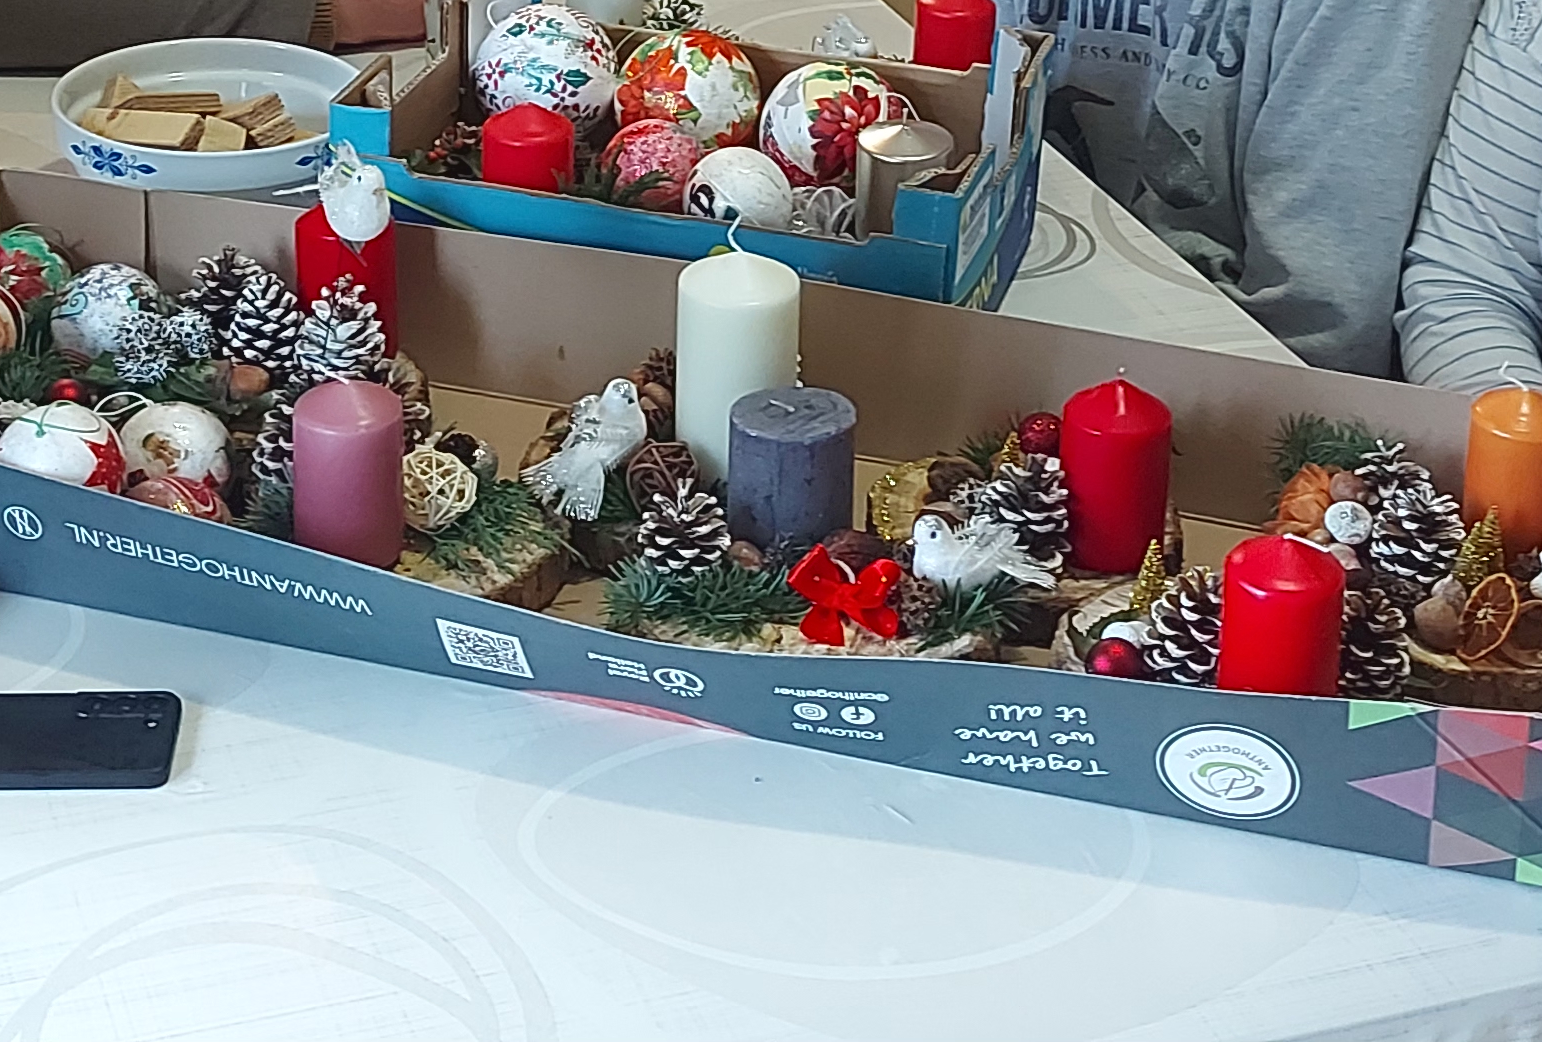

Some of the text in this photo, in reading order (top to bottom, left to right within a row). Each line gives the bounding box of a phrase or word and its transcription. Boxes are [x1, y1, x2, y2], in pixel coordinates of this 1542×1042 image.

[64, 521, 374, 616] WWW.ANTHOGETHER.NL
[987, 705, 1088, 725] it all!
[817, 725, 885, 741] FOLLOW
[954, 727, 1095, 748] we have
[961, 752, 1109, 776] Together
[1184, 743, 1273, 773] ANTHOGETHER
